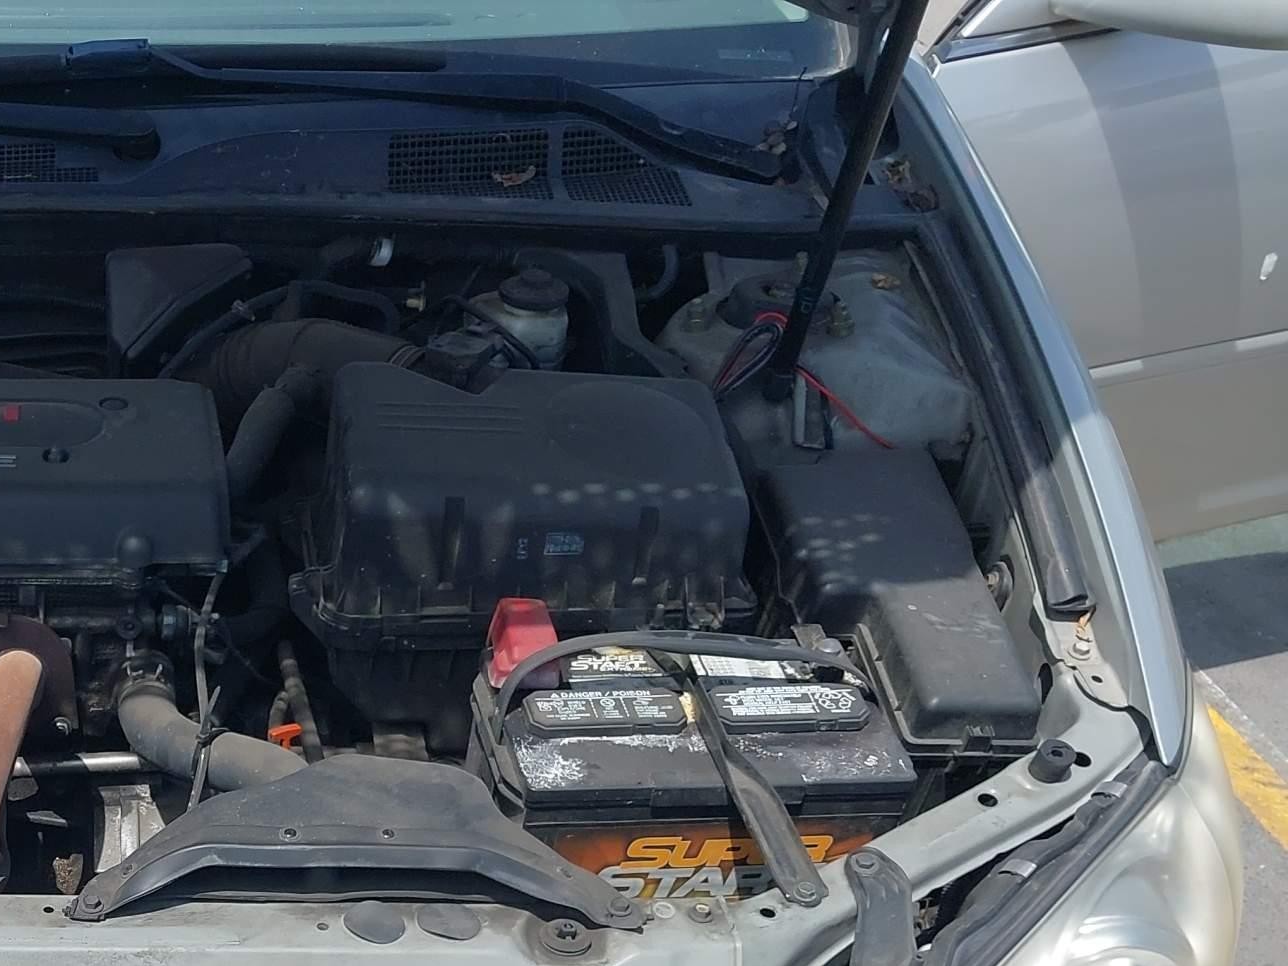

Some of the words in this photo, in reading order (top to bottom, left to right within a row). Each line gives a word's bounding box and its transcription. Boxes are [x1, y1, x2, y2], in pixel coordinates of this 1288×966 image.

[577, 654, 644, 662] SUPER
[561, 691, 602, 699] DANGER
[620, 835, 834, 868] SUPR
